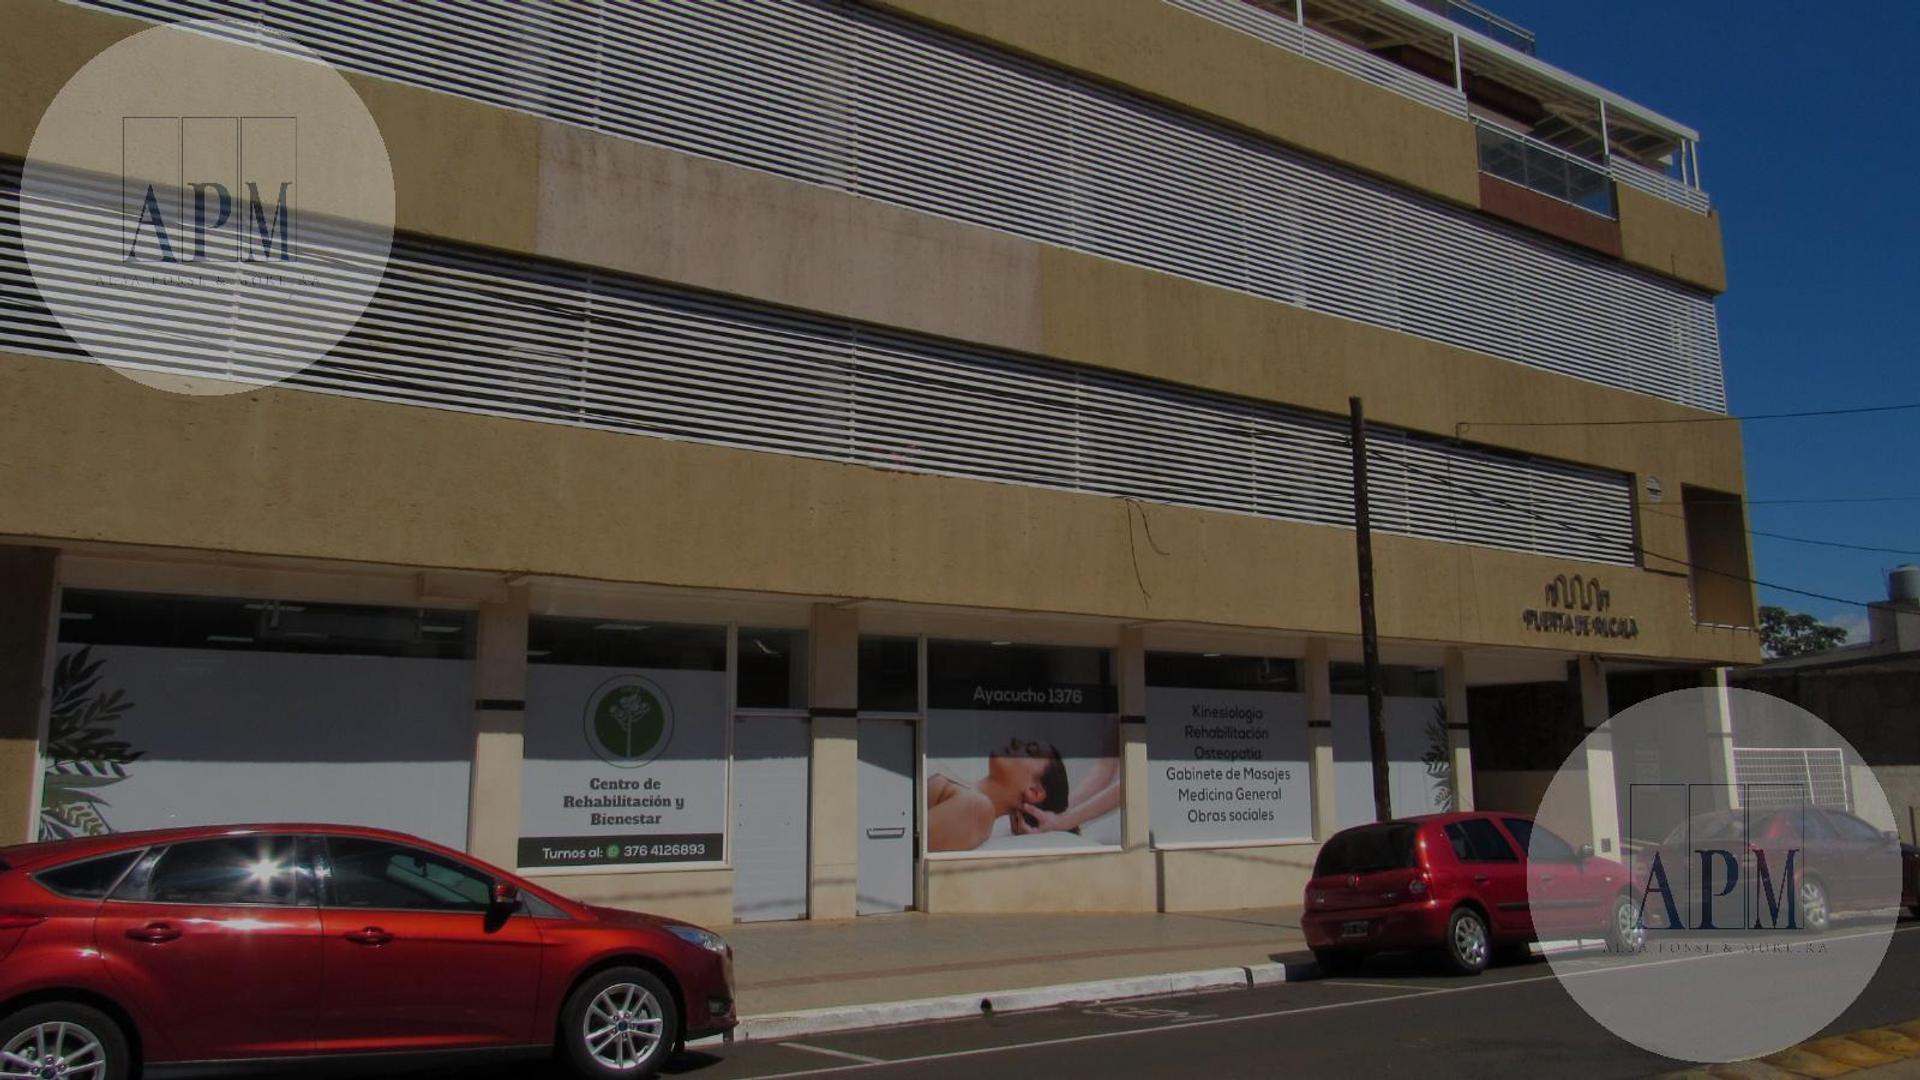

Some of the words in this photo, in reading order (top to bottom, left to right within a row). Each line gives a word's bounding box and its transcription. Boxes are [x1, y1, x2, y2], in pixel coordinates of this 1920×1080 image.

[973, 685, 1046, 705] Ayacucho
[1048, 687, 1083, 704] 1376
[1166, 767, 1223, 780] Gabinete
[1225, 767, 1241, 780] de
[1243, 767, 1291, 784] Masajes
[590, 777, 640, 790] Centro
[643, 777, 662, 790] de
[563, 794, 672, 809] Rehabilitación
[675, 797, 685, 810] y
[1178, 788, 1233, 802] Medicina
[1235, 787, 1282, 801] General
[590, 812, 662, 826] Bienestar
[1187, 808, 1227, 823] Obras
[1228, 808, 1275, 821] sociales
[542, 847, 586, 860] Turnos
[587, 846, 604, 859] al:
[623, 844, 649, 857] 376
[650, 843, 706, 857] 4126893
